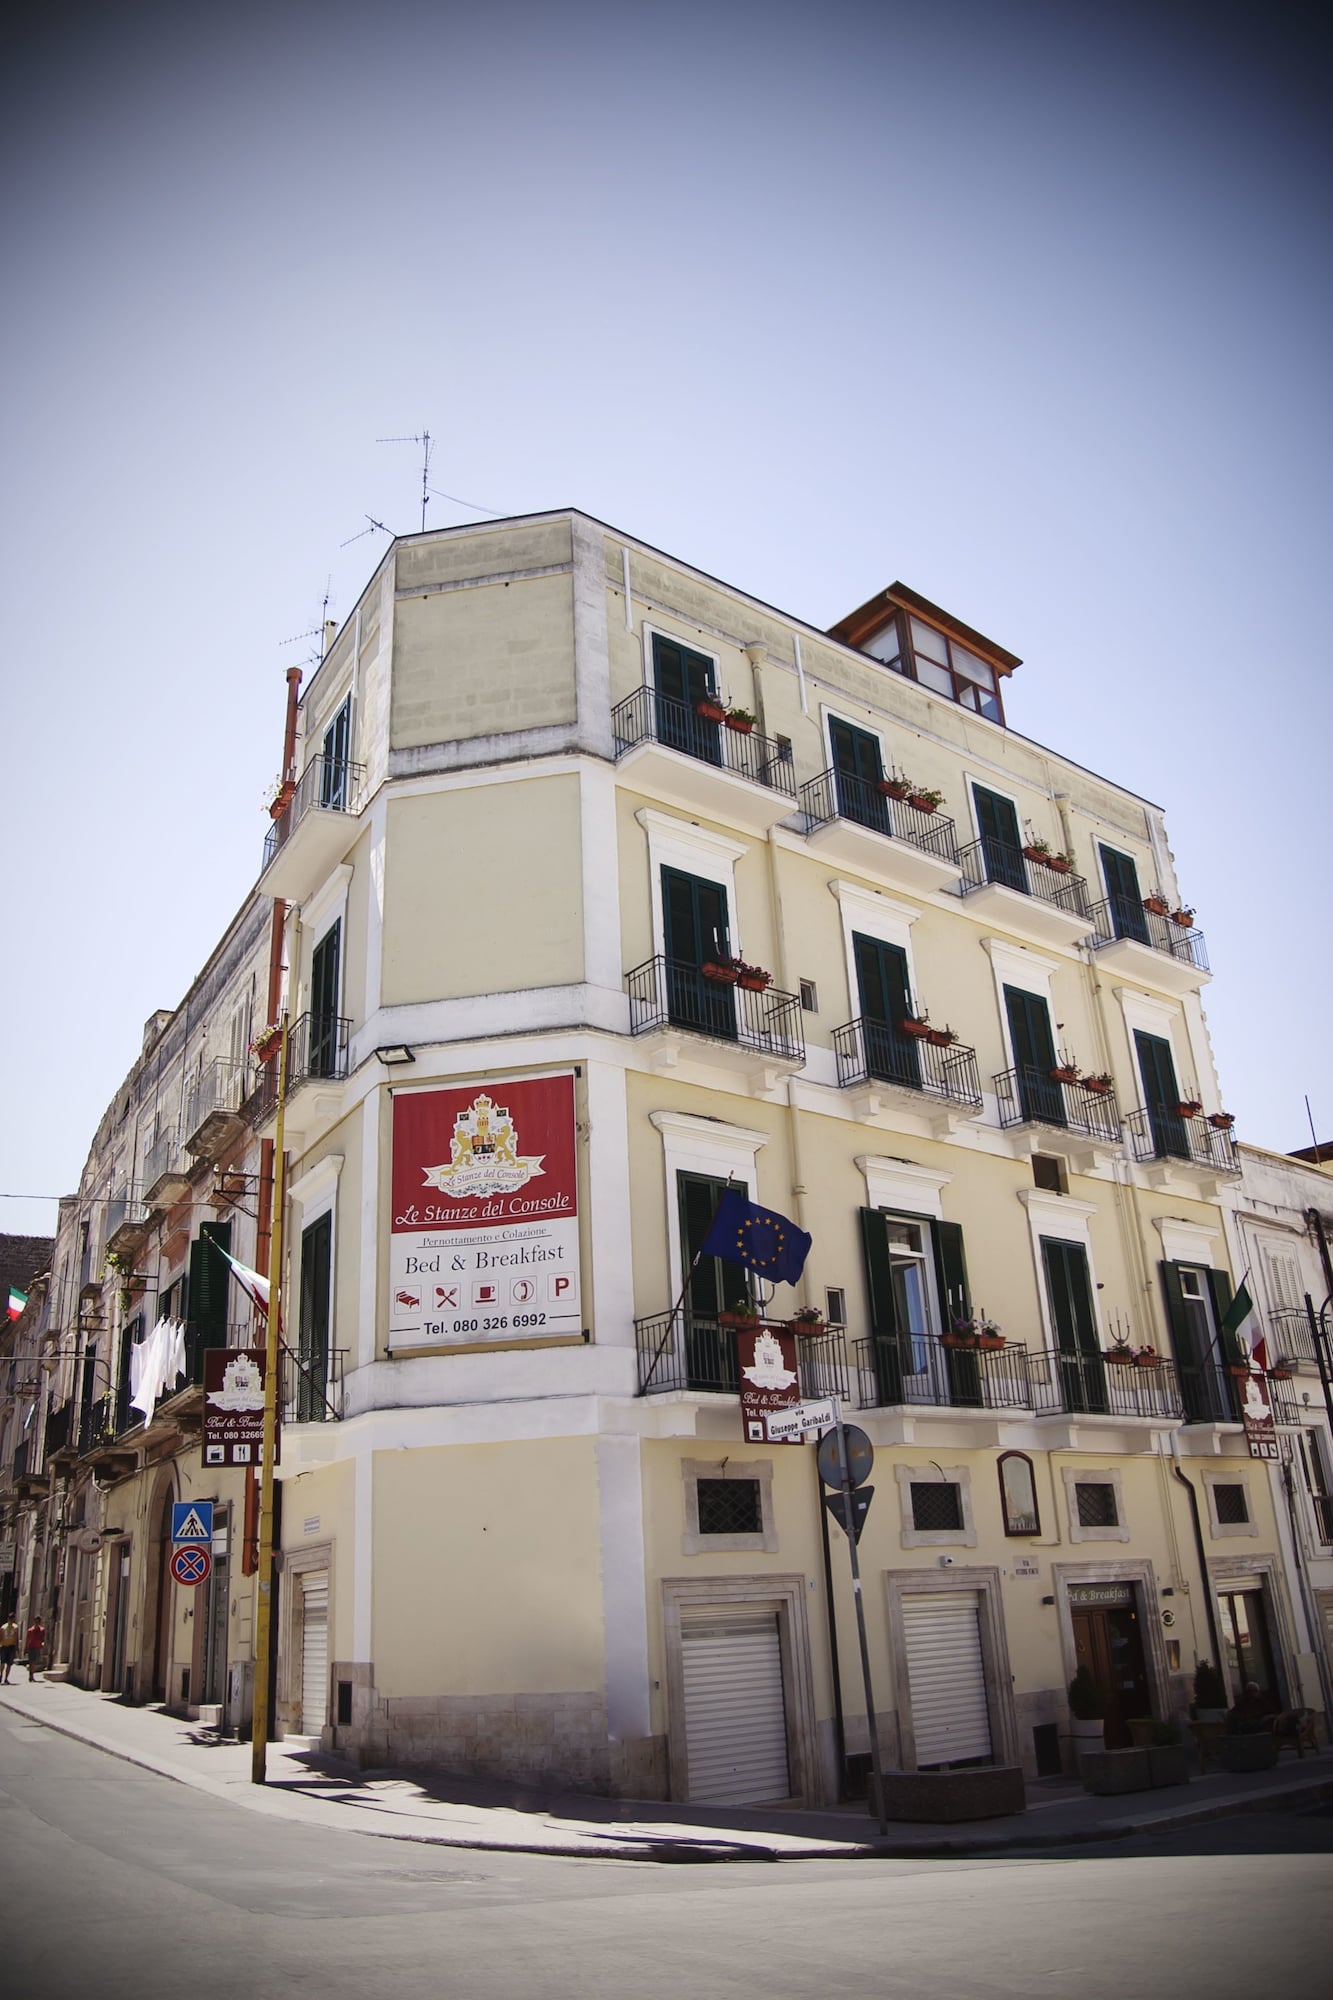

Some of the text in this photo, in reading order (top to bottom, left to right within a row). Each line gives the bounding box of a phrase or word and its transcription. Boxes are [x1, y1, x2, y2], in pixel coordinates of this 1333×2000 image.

[443, 1169, 525, 1187] Le Stanze del Console
[395, 1192, 570, 1225] Le Stanze del Console
[422, 1234, 493, 1247] Pernottamento
[502, 1227, 548, 1240] Colazione
[405, 1244, 565, 1274] Bed & Breakfast
[424, 1312, 547, 1335] Tel. 080 326 6992
[743, 1392, 760, 1405] Bed
[760, 1394, 768, 1405] &
[744, 1407, 758, 1418] Tel.
[795, 1409, 805, 1417] via
[205, 1415, 228, 1428] Bed
[227, 1417, 237, 1428] &
[770, 1412, 831, 1435] Giuseppe Garibaldi
[207, 1431, 222, 1440] Tel.
[223, 1431, 239, 1440] 080
[1079, 1590, 1088, 1601] &
[1088, 1586, 1130, 1603] Breakfast
